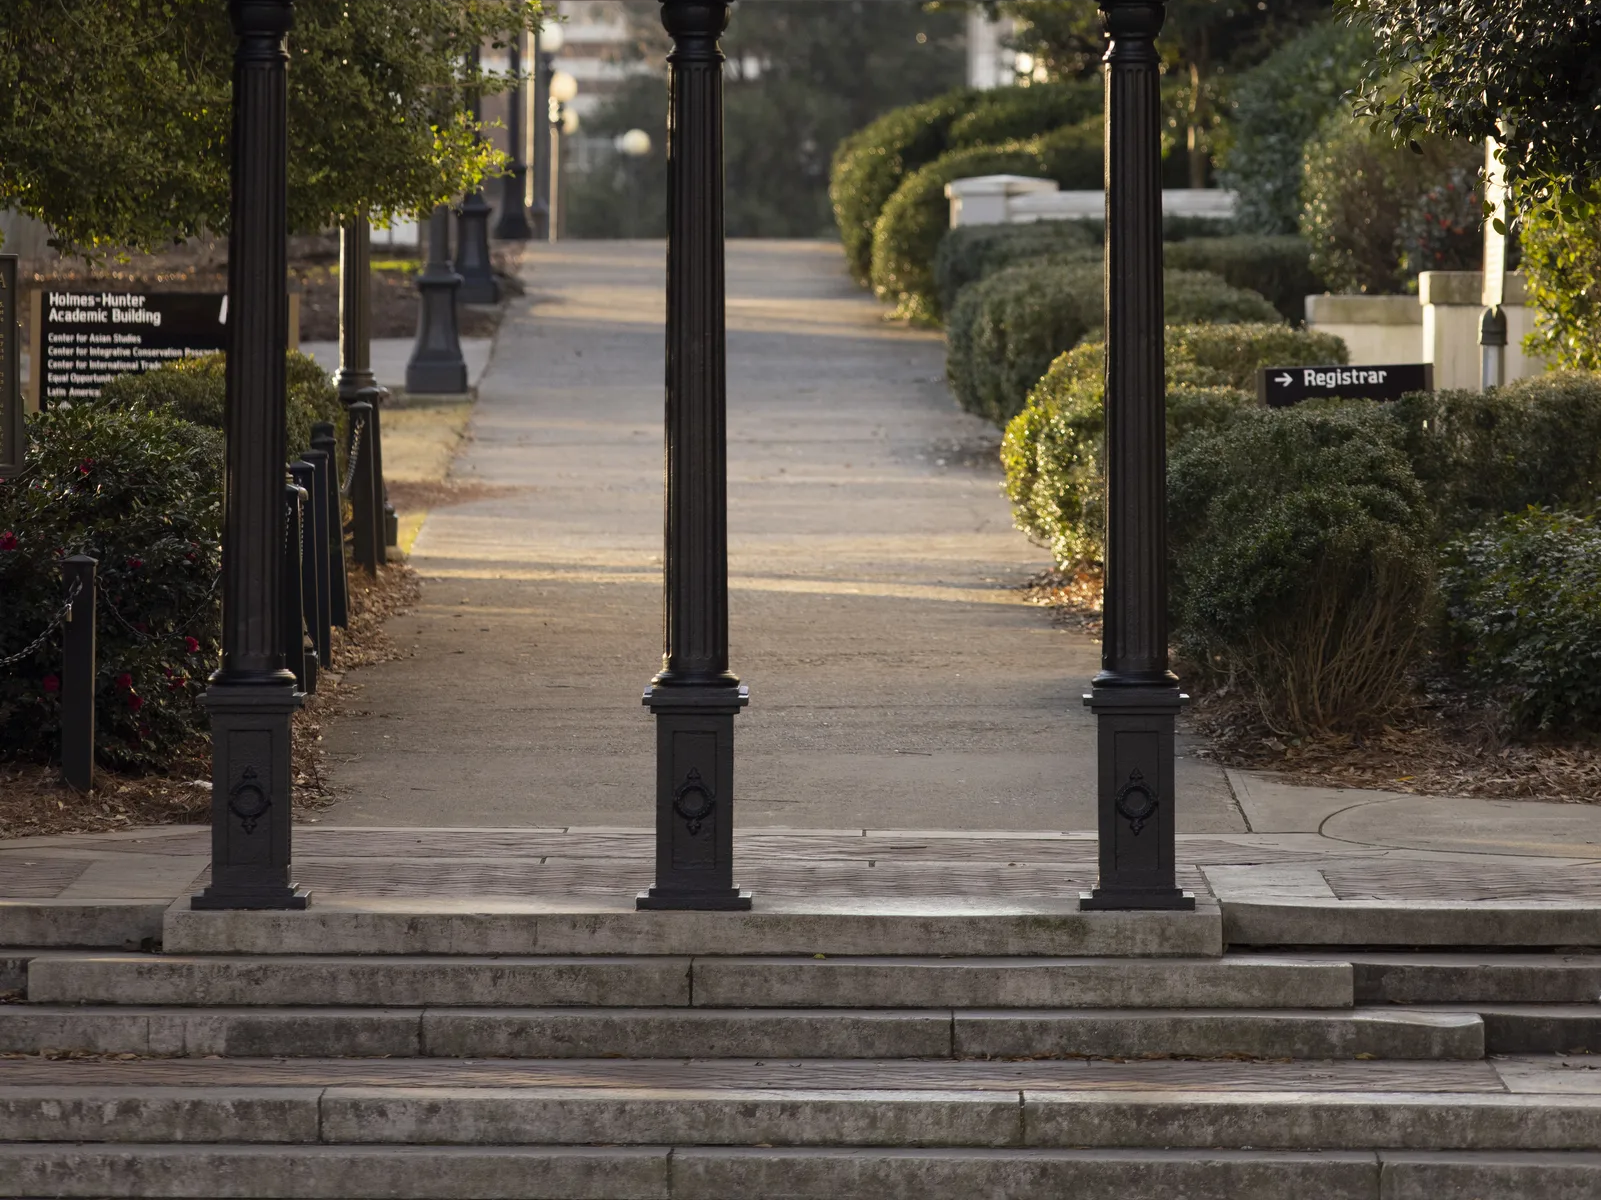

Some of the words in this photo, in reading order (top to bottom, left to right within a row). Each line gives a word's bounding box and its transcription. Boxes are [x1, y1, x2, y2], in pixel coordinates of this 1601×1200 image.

[49, 292, 146, 307] Holmes-Hunter
[48, 307, 108, 323] Academic
[111, 308, 161, 327] Building
[48, 332, 74, 343] Center
[76, 333, 88, 343] for
[89, 333, 112, 344] Asian
[113, 333, 142, 344] Studies
[48, 346, 74, 356] Center
[76, 346, 88, 356] for
[89, 346, 131, 359] Integrative
[132, 347, 184, 357] Conservation
[47, 359, 74, 369] Center
[76, 360, 88, 370] for
[89, 360, 139, 370] International
[47, 372, 69, 384] Equal
[1303, 368, 1387, 389] Registrar
[47, 386, 66, 397] Latin
